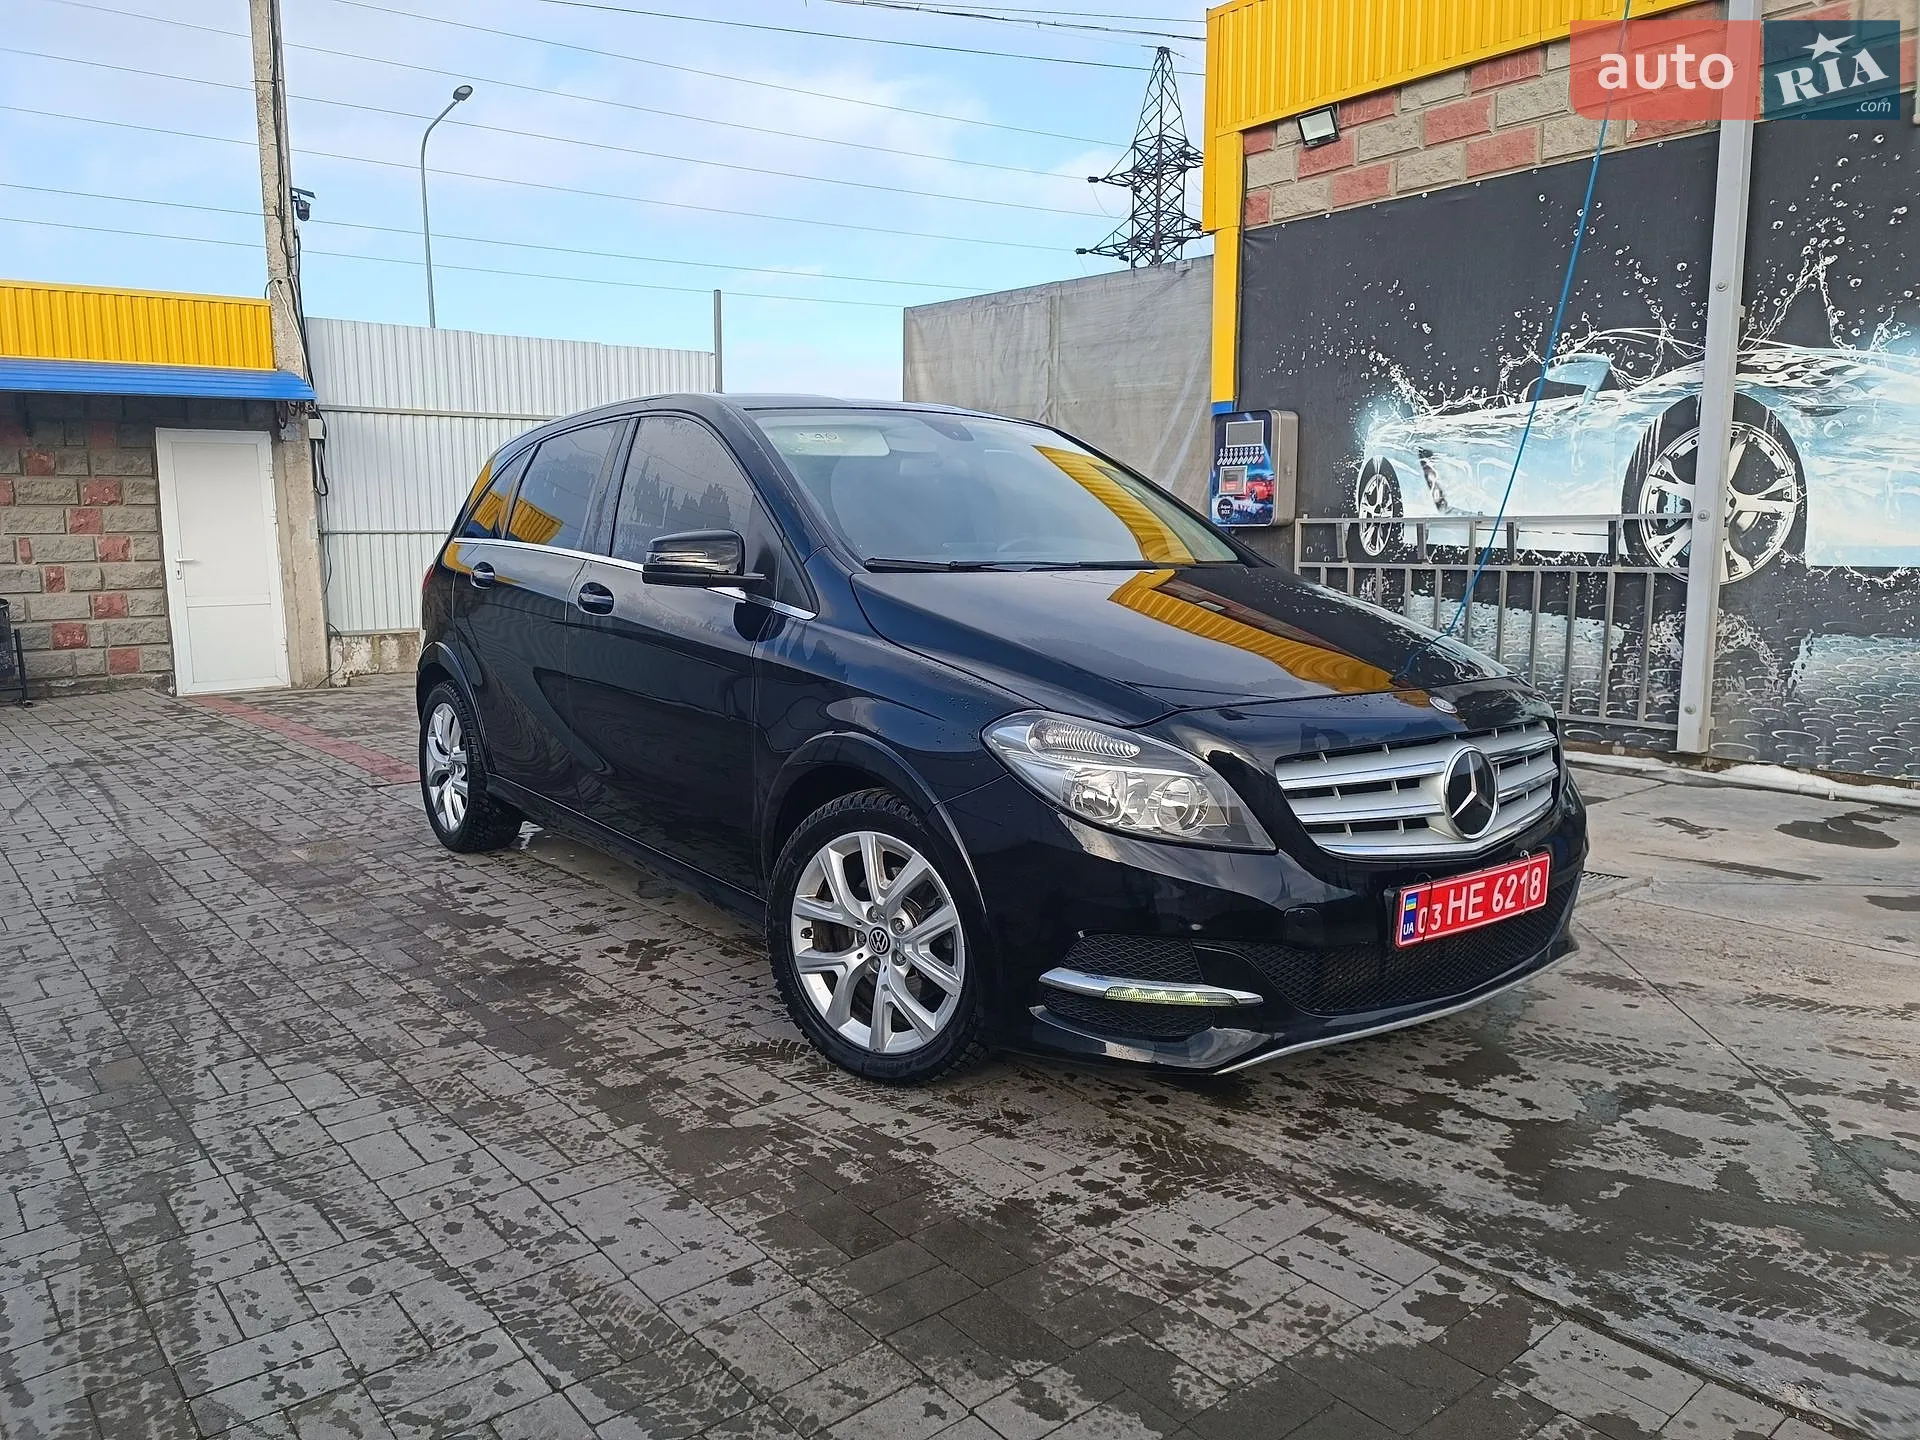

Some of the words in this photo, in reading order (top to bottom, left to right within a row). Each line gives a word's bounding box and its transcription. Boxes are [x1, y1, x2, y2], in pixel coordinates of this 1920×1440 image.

[1417, 903, 1442, 934] 03
[1447, 882, 1485, 925] HE
[1491, 866, 1542, 914] 6218
[1403, 923, 1414, 935] UA
